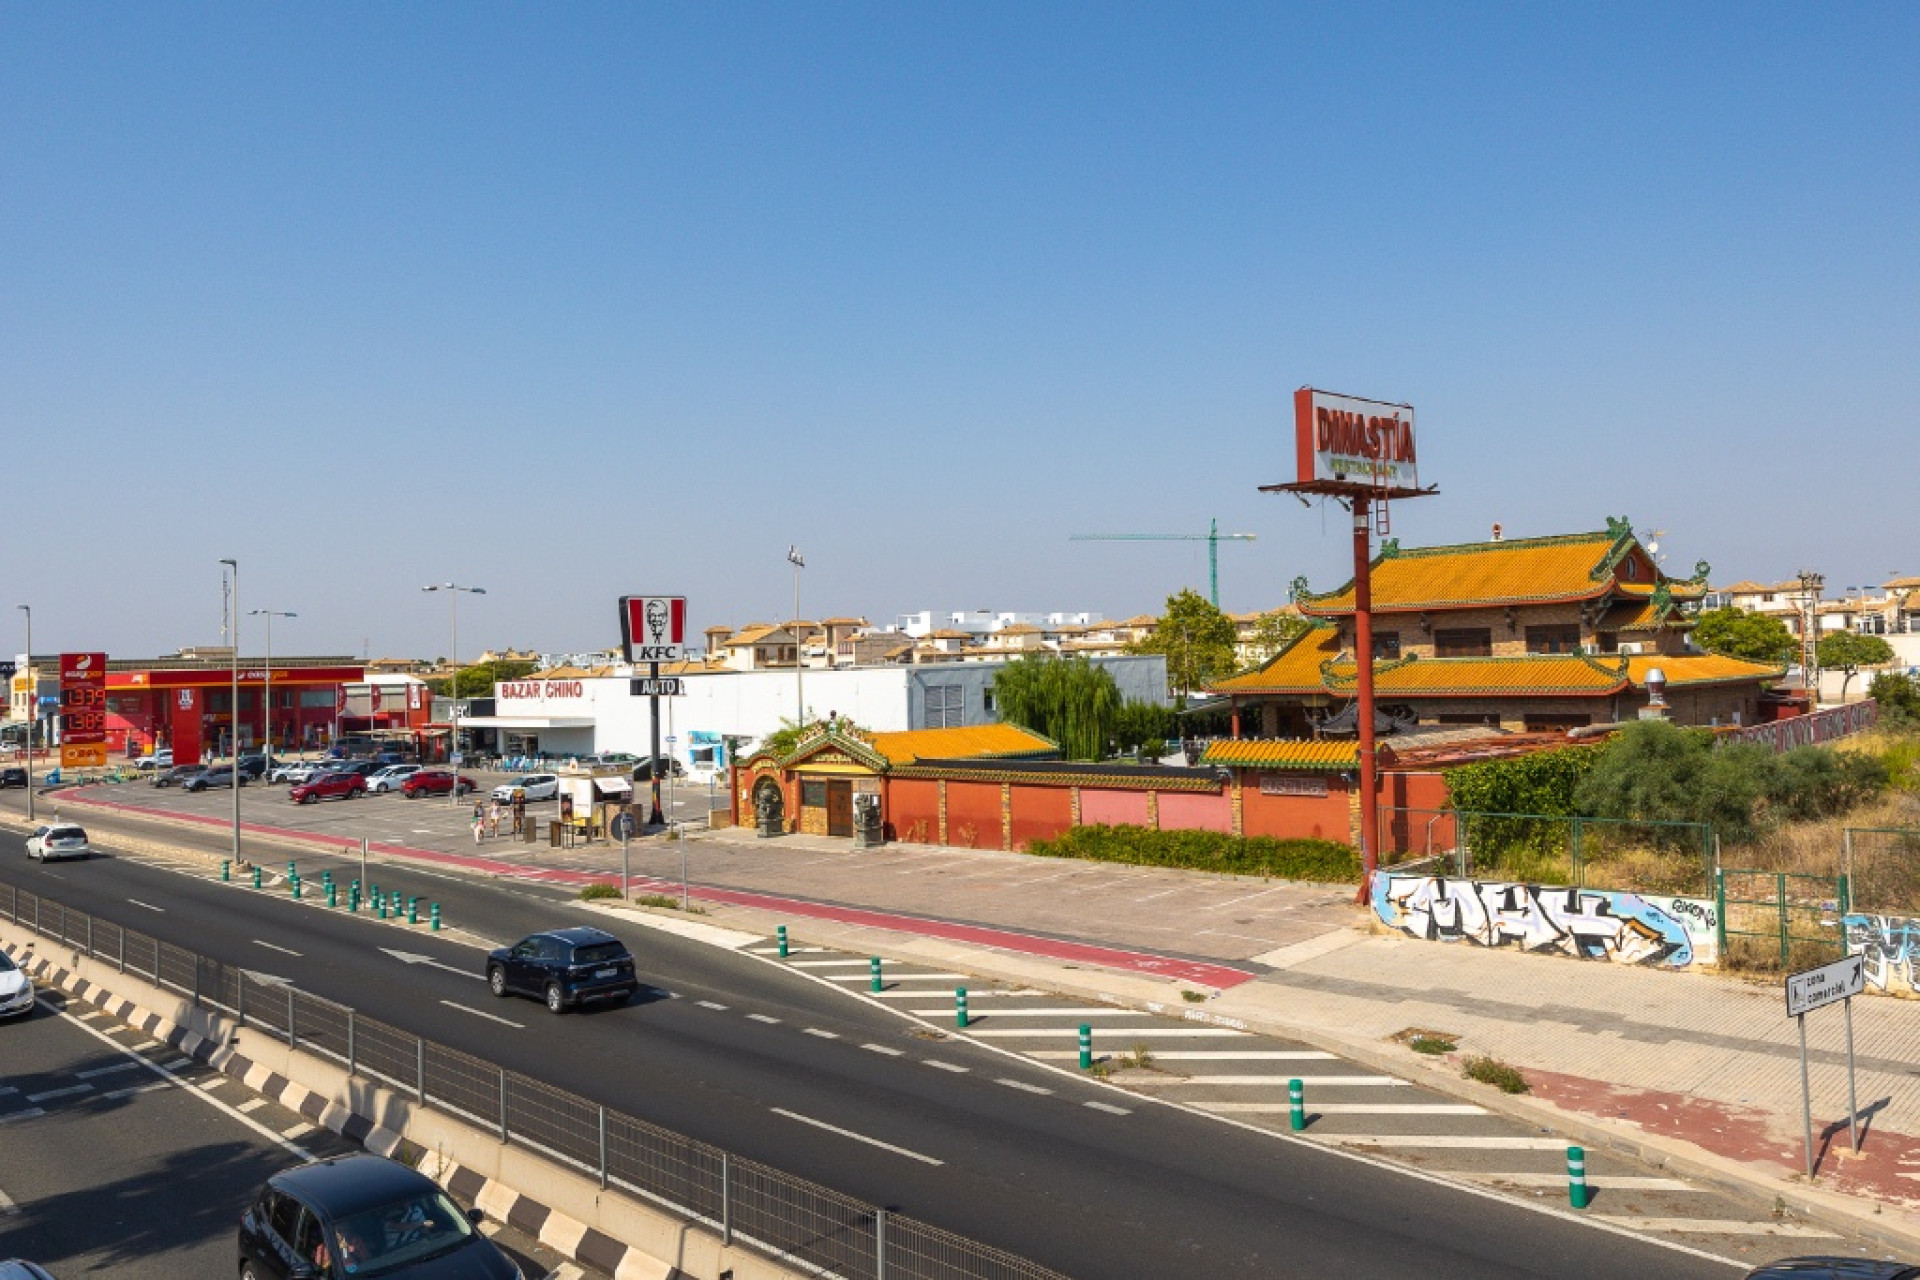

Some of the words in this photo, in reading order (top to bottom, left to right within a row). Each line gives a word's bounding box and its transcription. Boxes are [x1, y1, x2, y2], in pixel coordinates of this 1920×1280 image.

[640, 646, 676, 659] KFC
[502, 683, 540, 699] BAZAR
[545, 682, 583, 698] CHINO
[1807, 974, 1825, 987] zona
[1808, 980, 1845, 1003] comercial
